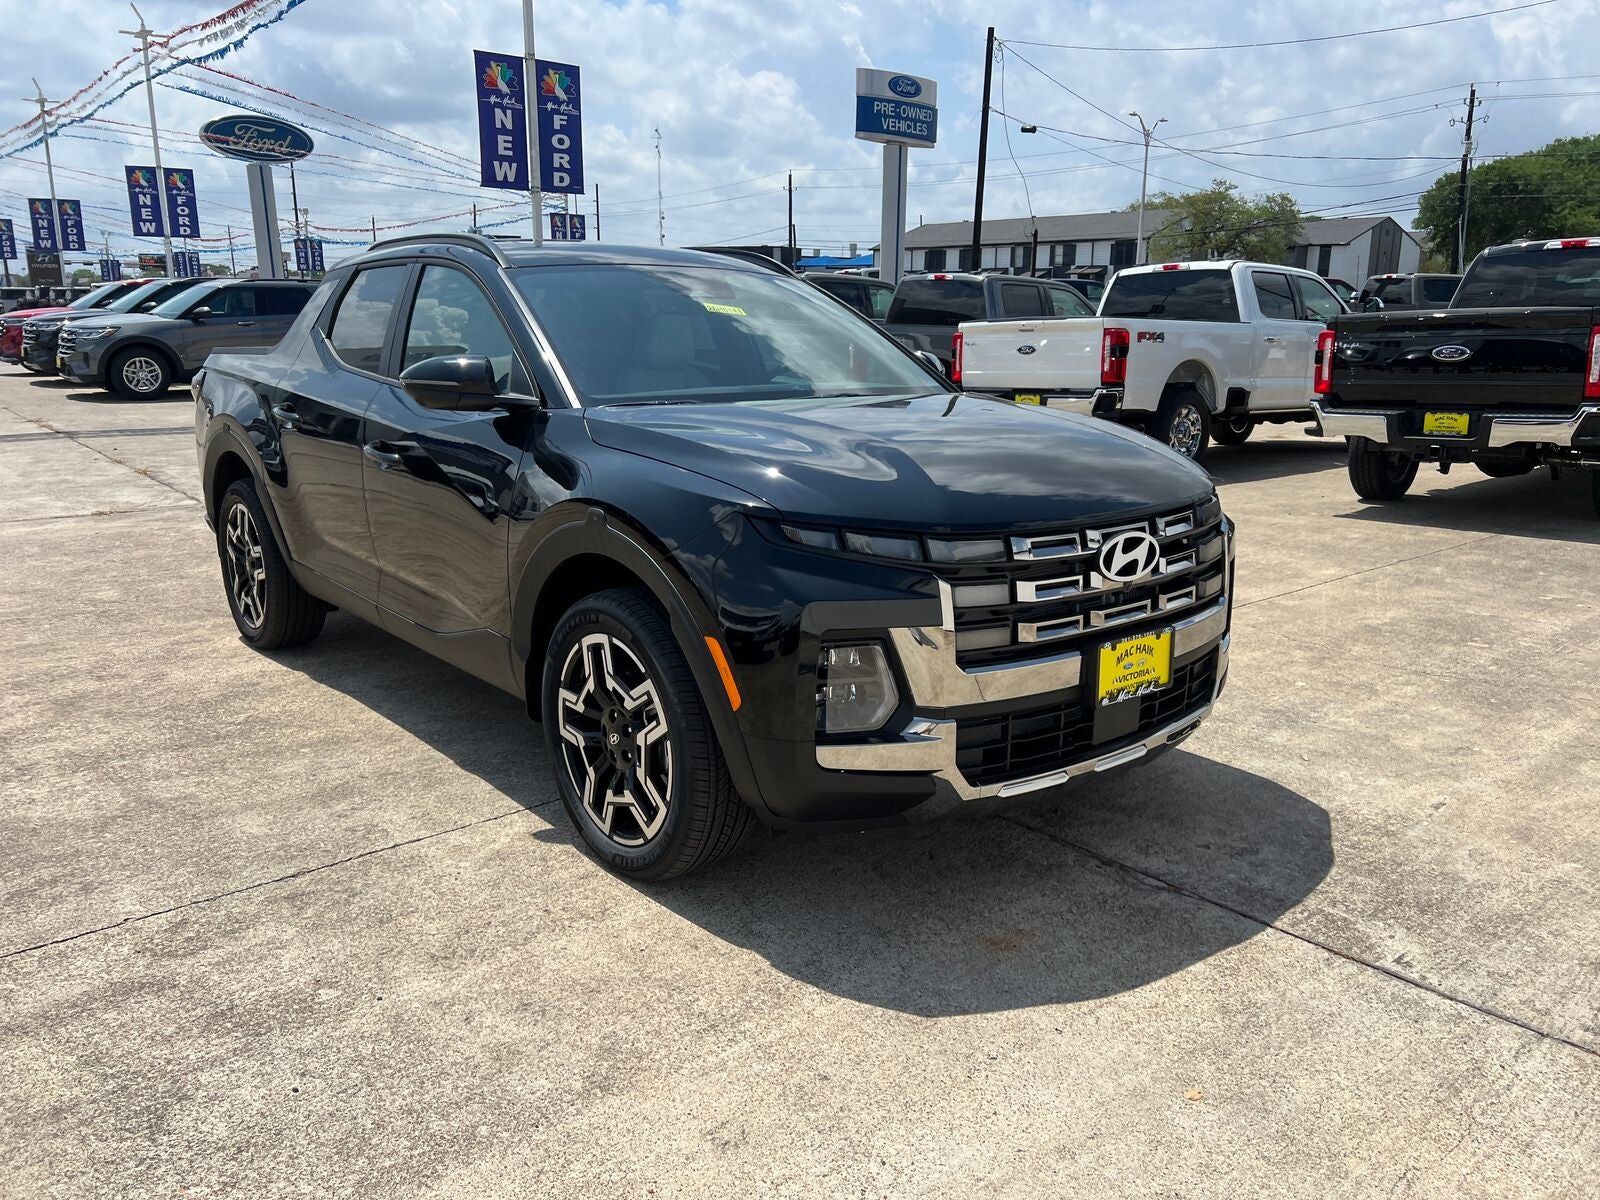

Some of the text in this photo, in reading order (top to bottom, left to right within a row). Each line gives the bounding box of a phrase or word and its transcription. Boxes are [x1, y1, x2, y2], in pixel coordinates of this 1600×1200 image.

[897, 79, 916, 93] Ford
[874, 101, 933, 121] PRE-OWNED
[229, 123, 292, 153] Ford
[881, 117, 928, 135] VEHICLES
[494, 108, 517, 182] NEW
[551, 114, 571, 187] FORD
[138, 193, 156, 233] NEW
[176, 196, 191, 235] FORD
[2, 234, 12, 258] FORD
[38, 219, 52, 248] NEW
[67, 220, 79, 249] FORD
[1137, 332, 1164, 343] FX4
[1116, 643, 1154, 667] MAC HAIK
[1118, 668, 1150, 683] VICTORIA
